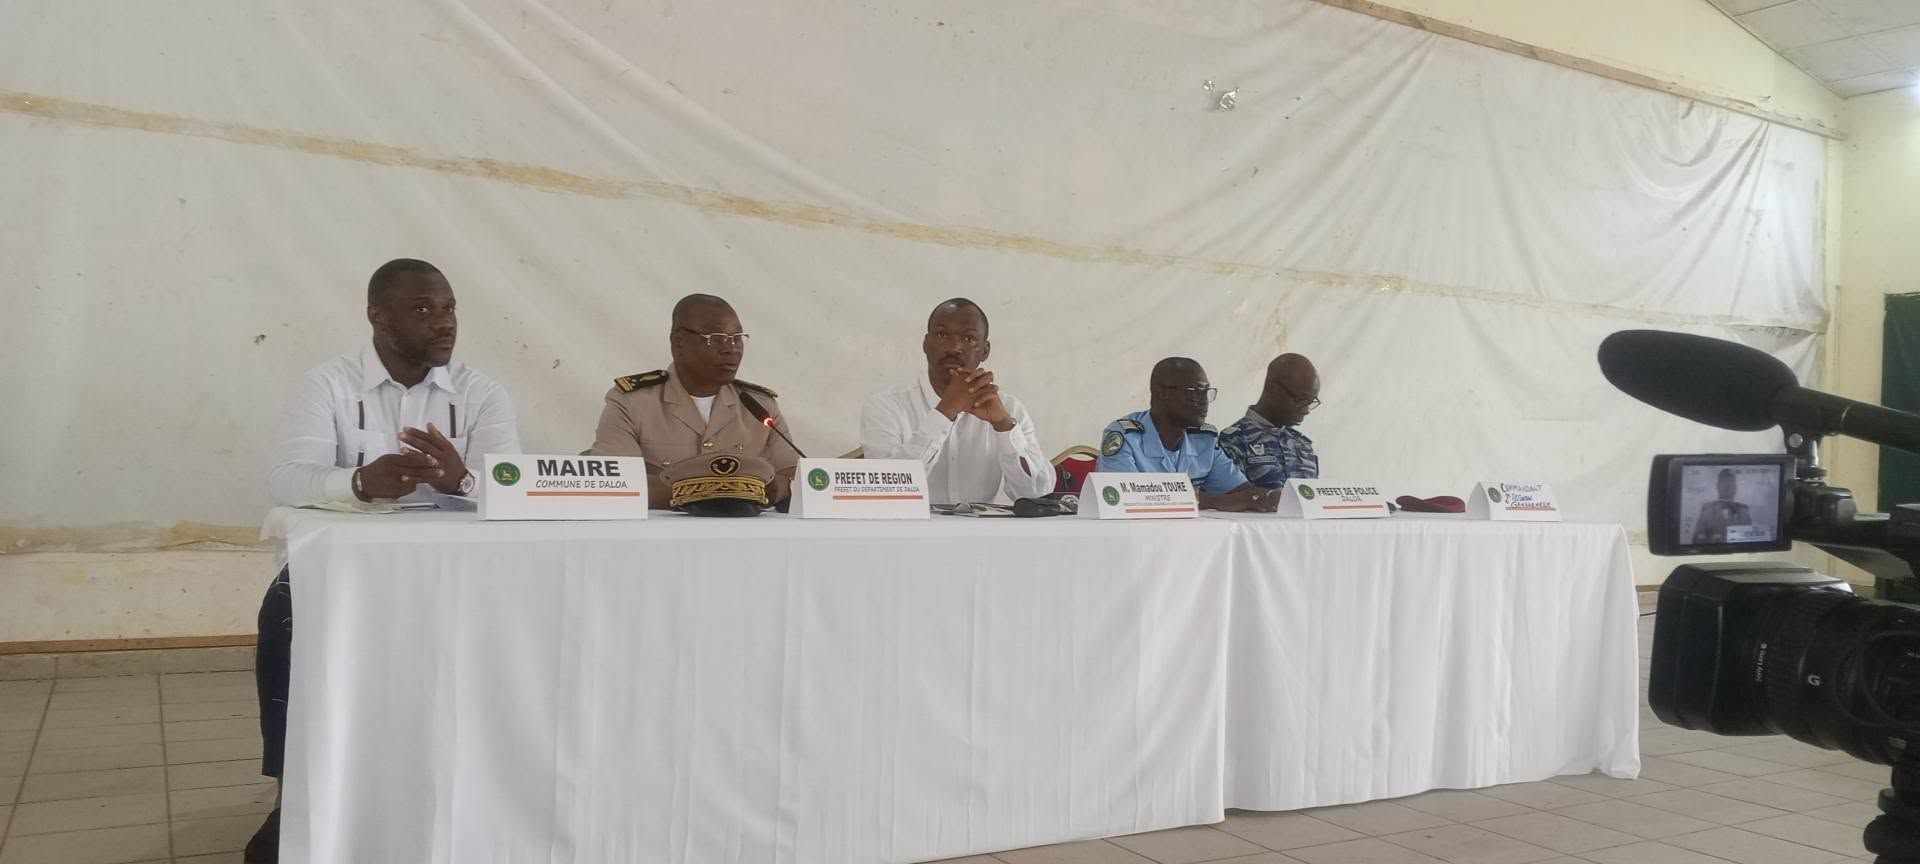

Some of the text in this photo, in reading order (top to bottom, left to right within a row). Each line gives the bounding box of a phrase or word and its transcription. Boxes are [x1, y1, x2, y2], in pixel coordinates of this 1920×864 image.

[537, 459, 621, 477] MAIRE
[535, 479, 628, 489] COMMUNE DE DALOA
[835, 472, 913, 485] PREFET DE REGION
[1129, 482, 1163, 493] Mamadou
[1162, 481, 1188, 493] TOURE
[1353, 487, 1380, 496] POLICE
[1807, 674, 1821, 687] G
